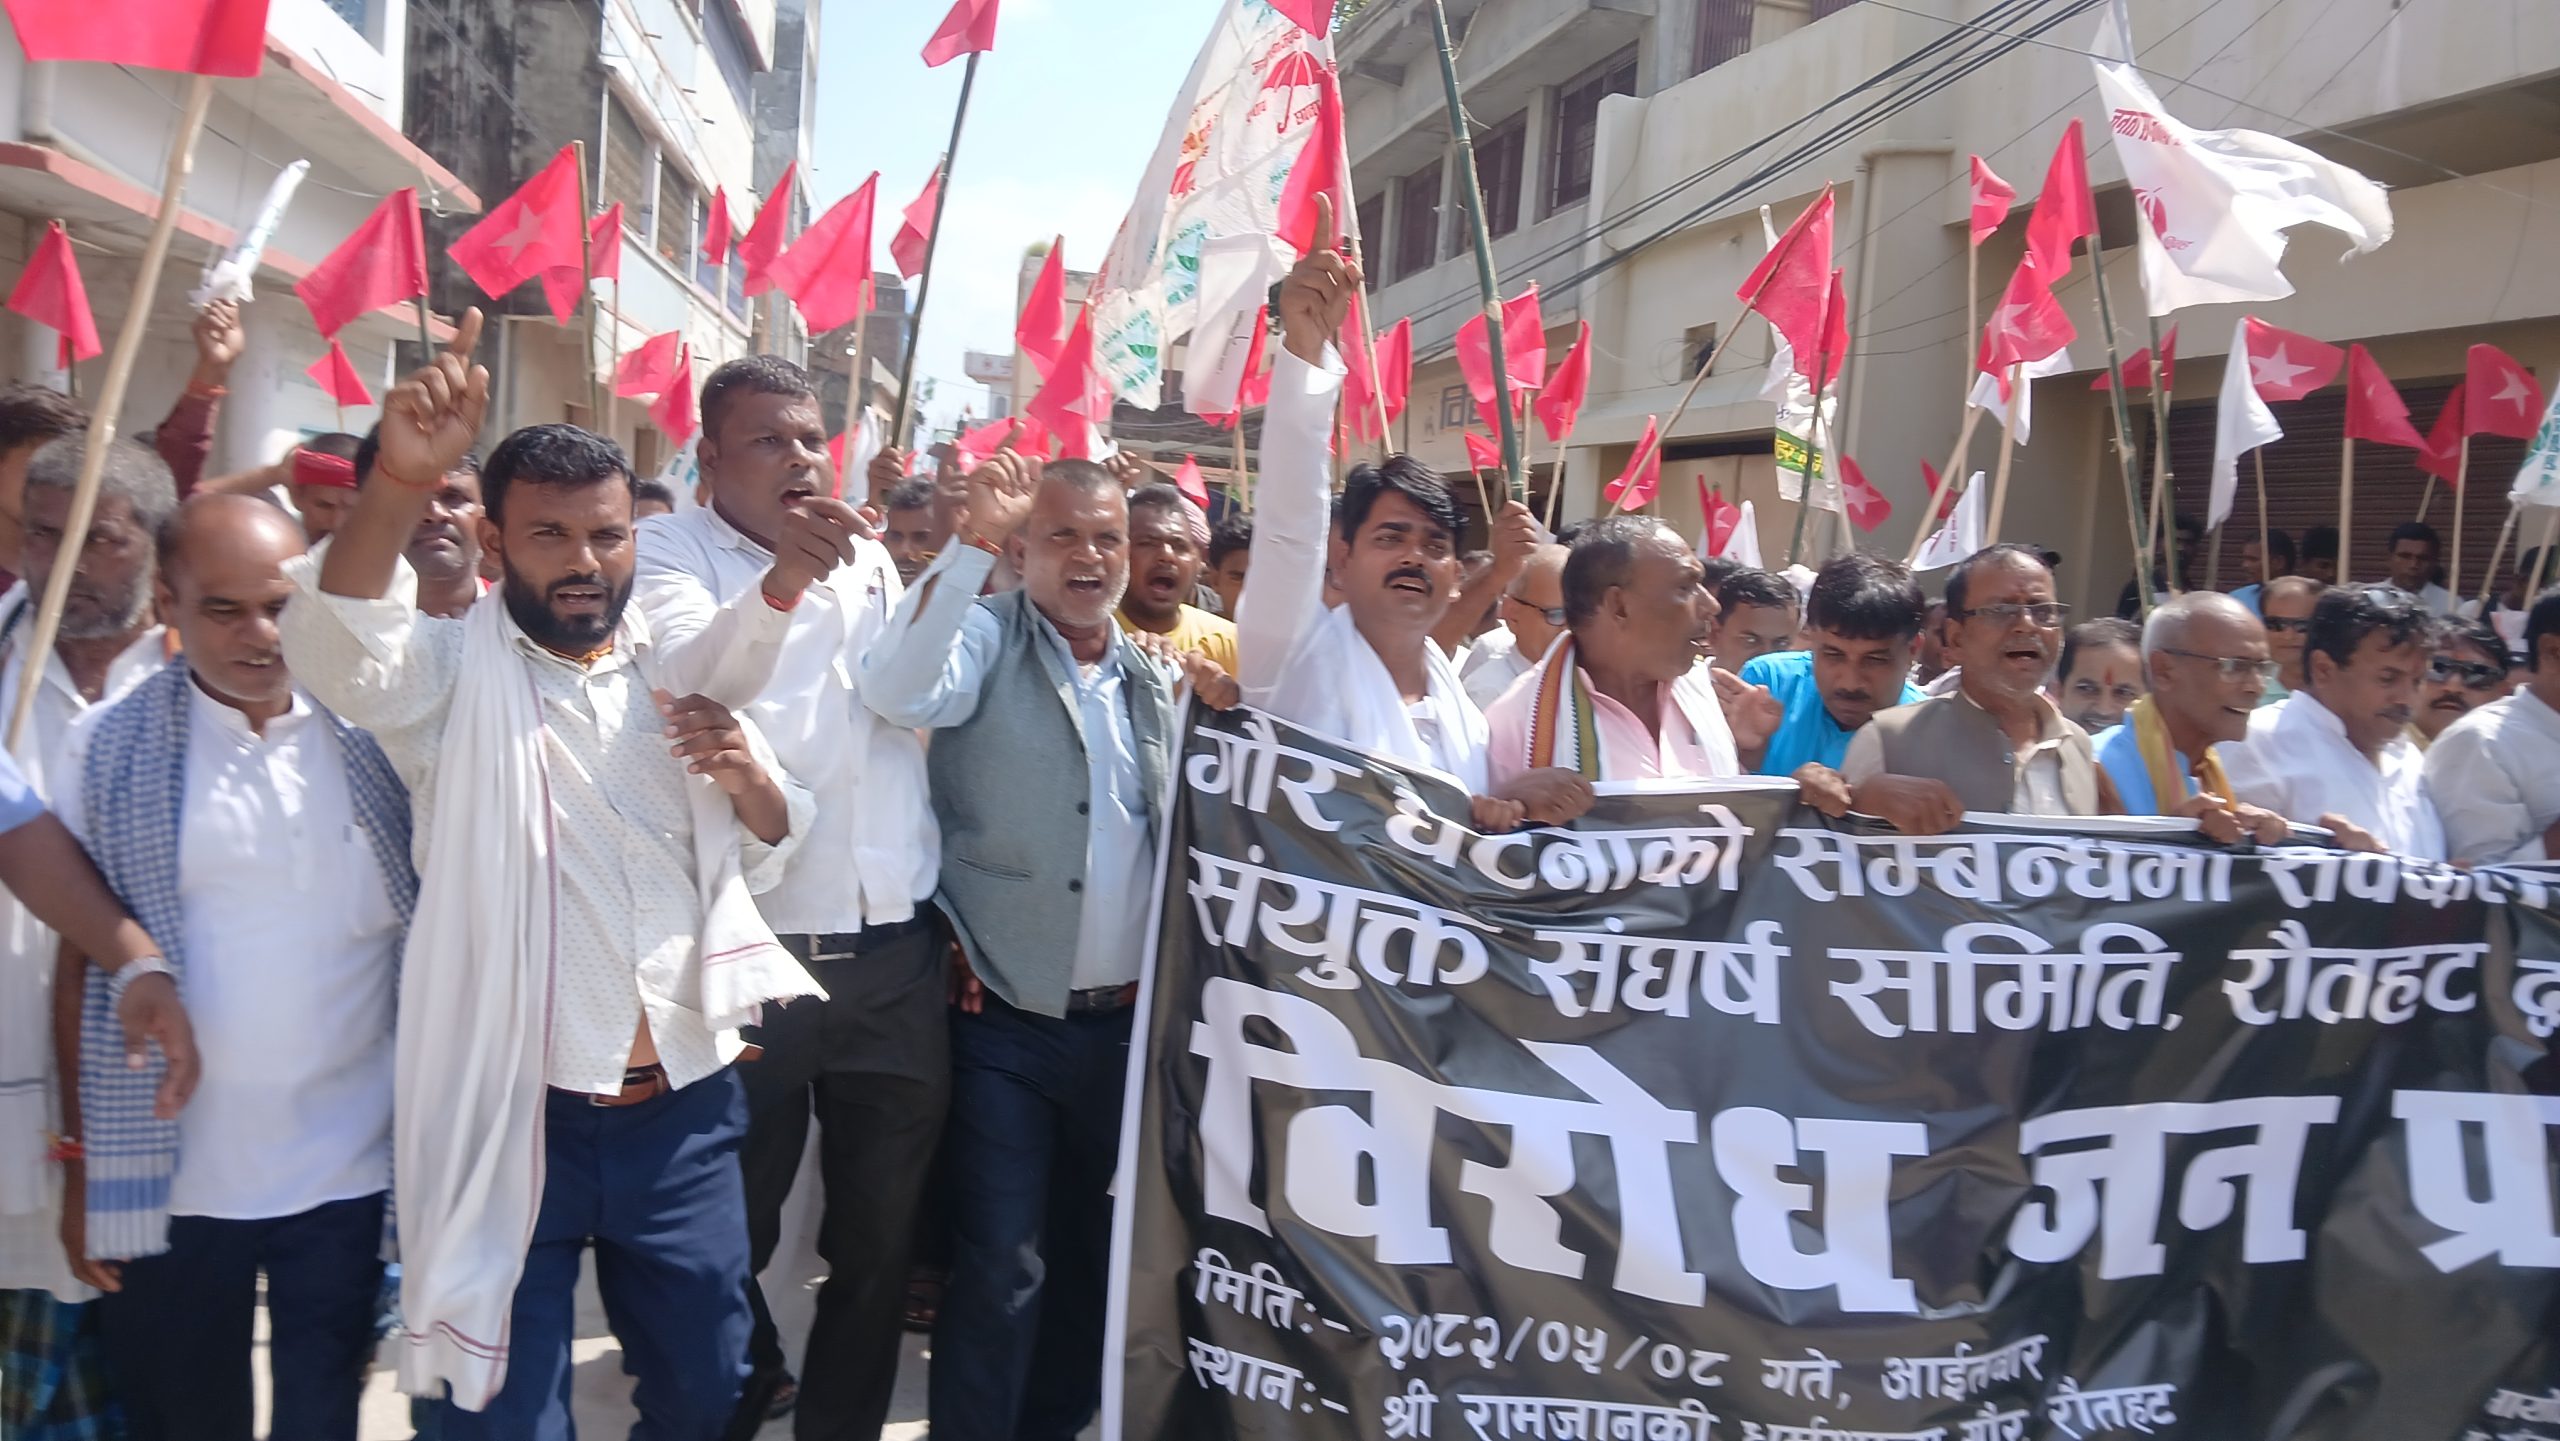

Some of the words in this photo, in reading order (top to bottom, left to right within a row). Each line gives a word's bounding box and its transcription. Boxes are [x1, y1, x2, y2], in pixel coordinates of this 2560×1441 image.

[1186, 708, 1362, 831] गौर
[1386, 785, 1754, 893] घटनाको
[1774, 827, 2230, 902] सम्बन्धमा
[1188, 845, 1503, 989] संयुक्त
[1529, 917, 1791, 1023] संघर्ष
[1827, 922, 2183, 1038] समिति,
[2222, 919, 2491, 1026] रौतहट
[1189, 976, 1928, 1313] विरोध
[2007, 1095, 2341, 1280] जन
[1379, 1313, 1731, 1388] २०८२/०५/०८
[1761, 1348, 1850, 1410] गते,
[1381, 1377, 1440, 1439] श्री
[1457, 1394, 1721, 1441] रामजानकी
[2047, 1375, 2179, 1440] रौतहट
